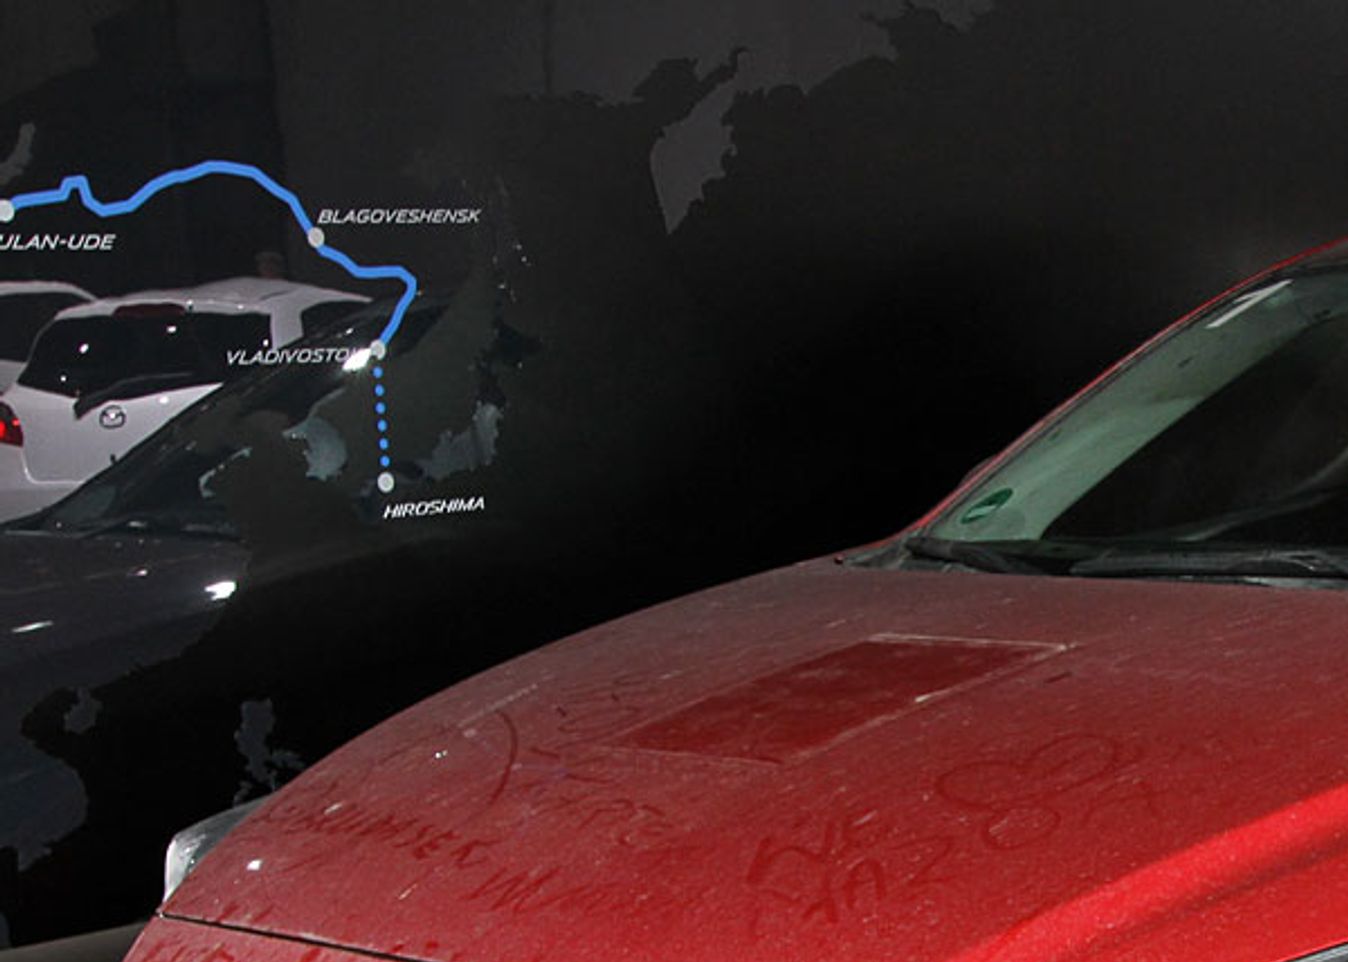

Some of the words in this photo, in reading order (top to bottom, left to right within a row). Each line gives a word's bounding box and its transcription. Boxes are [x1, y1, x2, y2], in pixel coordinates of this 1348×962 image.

[317, 208, 482, 224] BLAGOVESHENSK
[226, 348, 360, 365] VLADIVOSTO
[382, 497, 486, 519] HIROSHIMA
